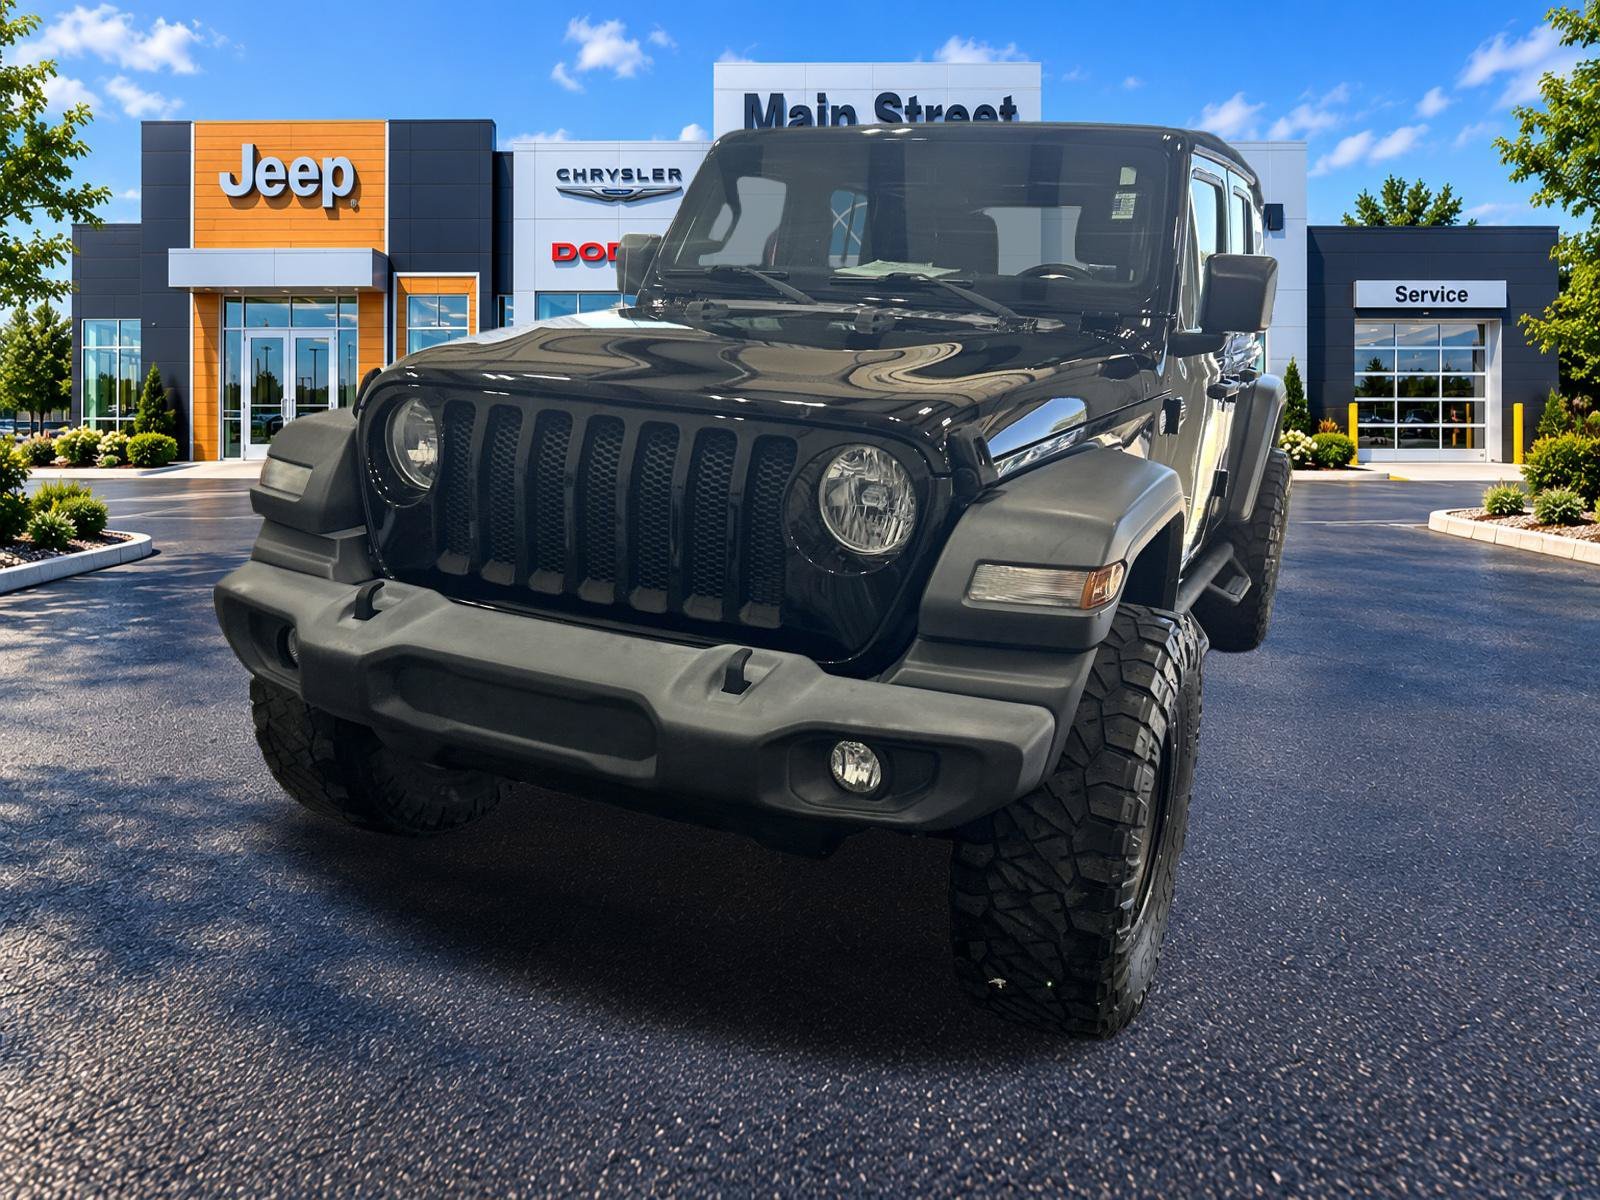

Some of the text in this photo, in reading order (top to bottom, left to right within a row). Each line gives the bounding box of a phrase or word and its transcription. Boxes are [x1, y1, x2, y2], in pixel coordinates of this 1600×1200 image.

[743, 91, 1018, 128] Main Street
[218, 143, 355, 208] Jeep
[556, 168, 683, 182] CHRYSLER
[1395, 285, 1469, 303] Service
